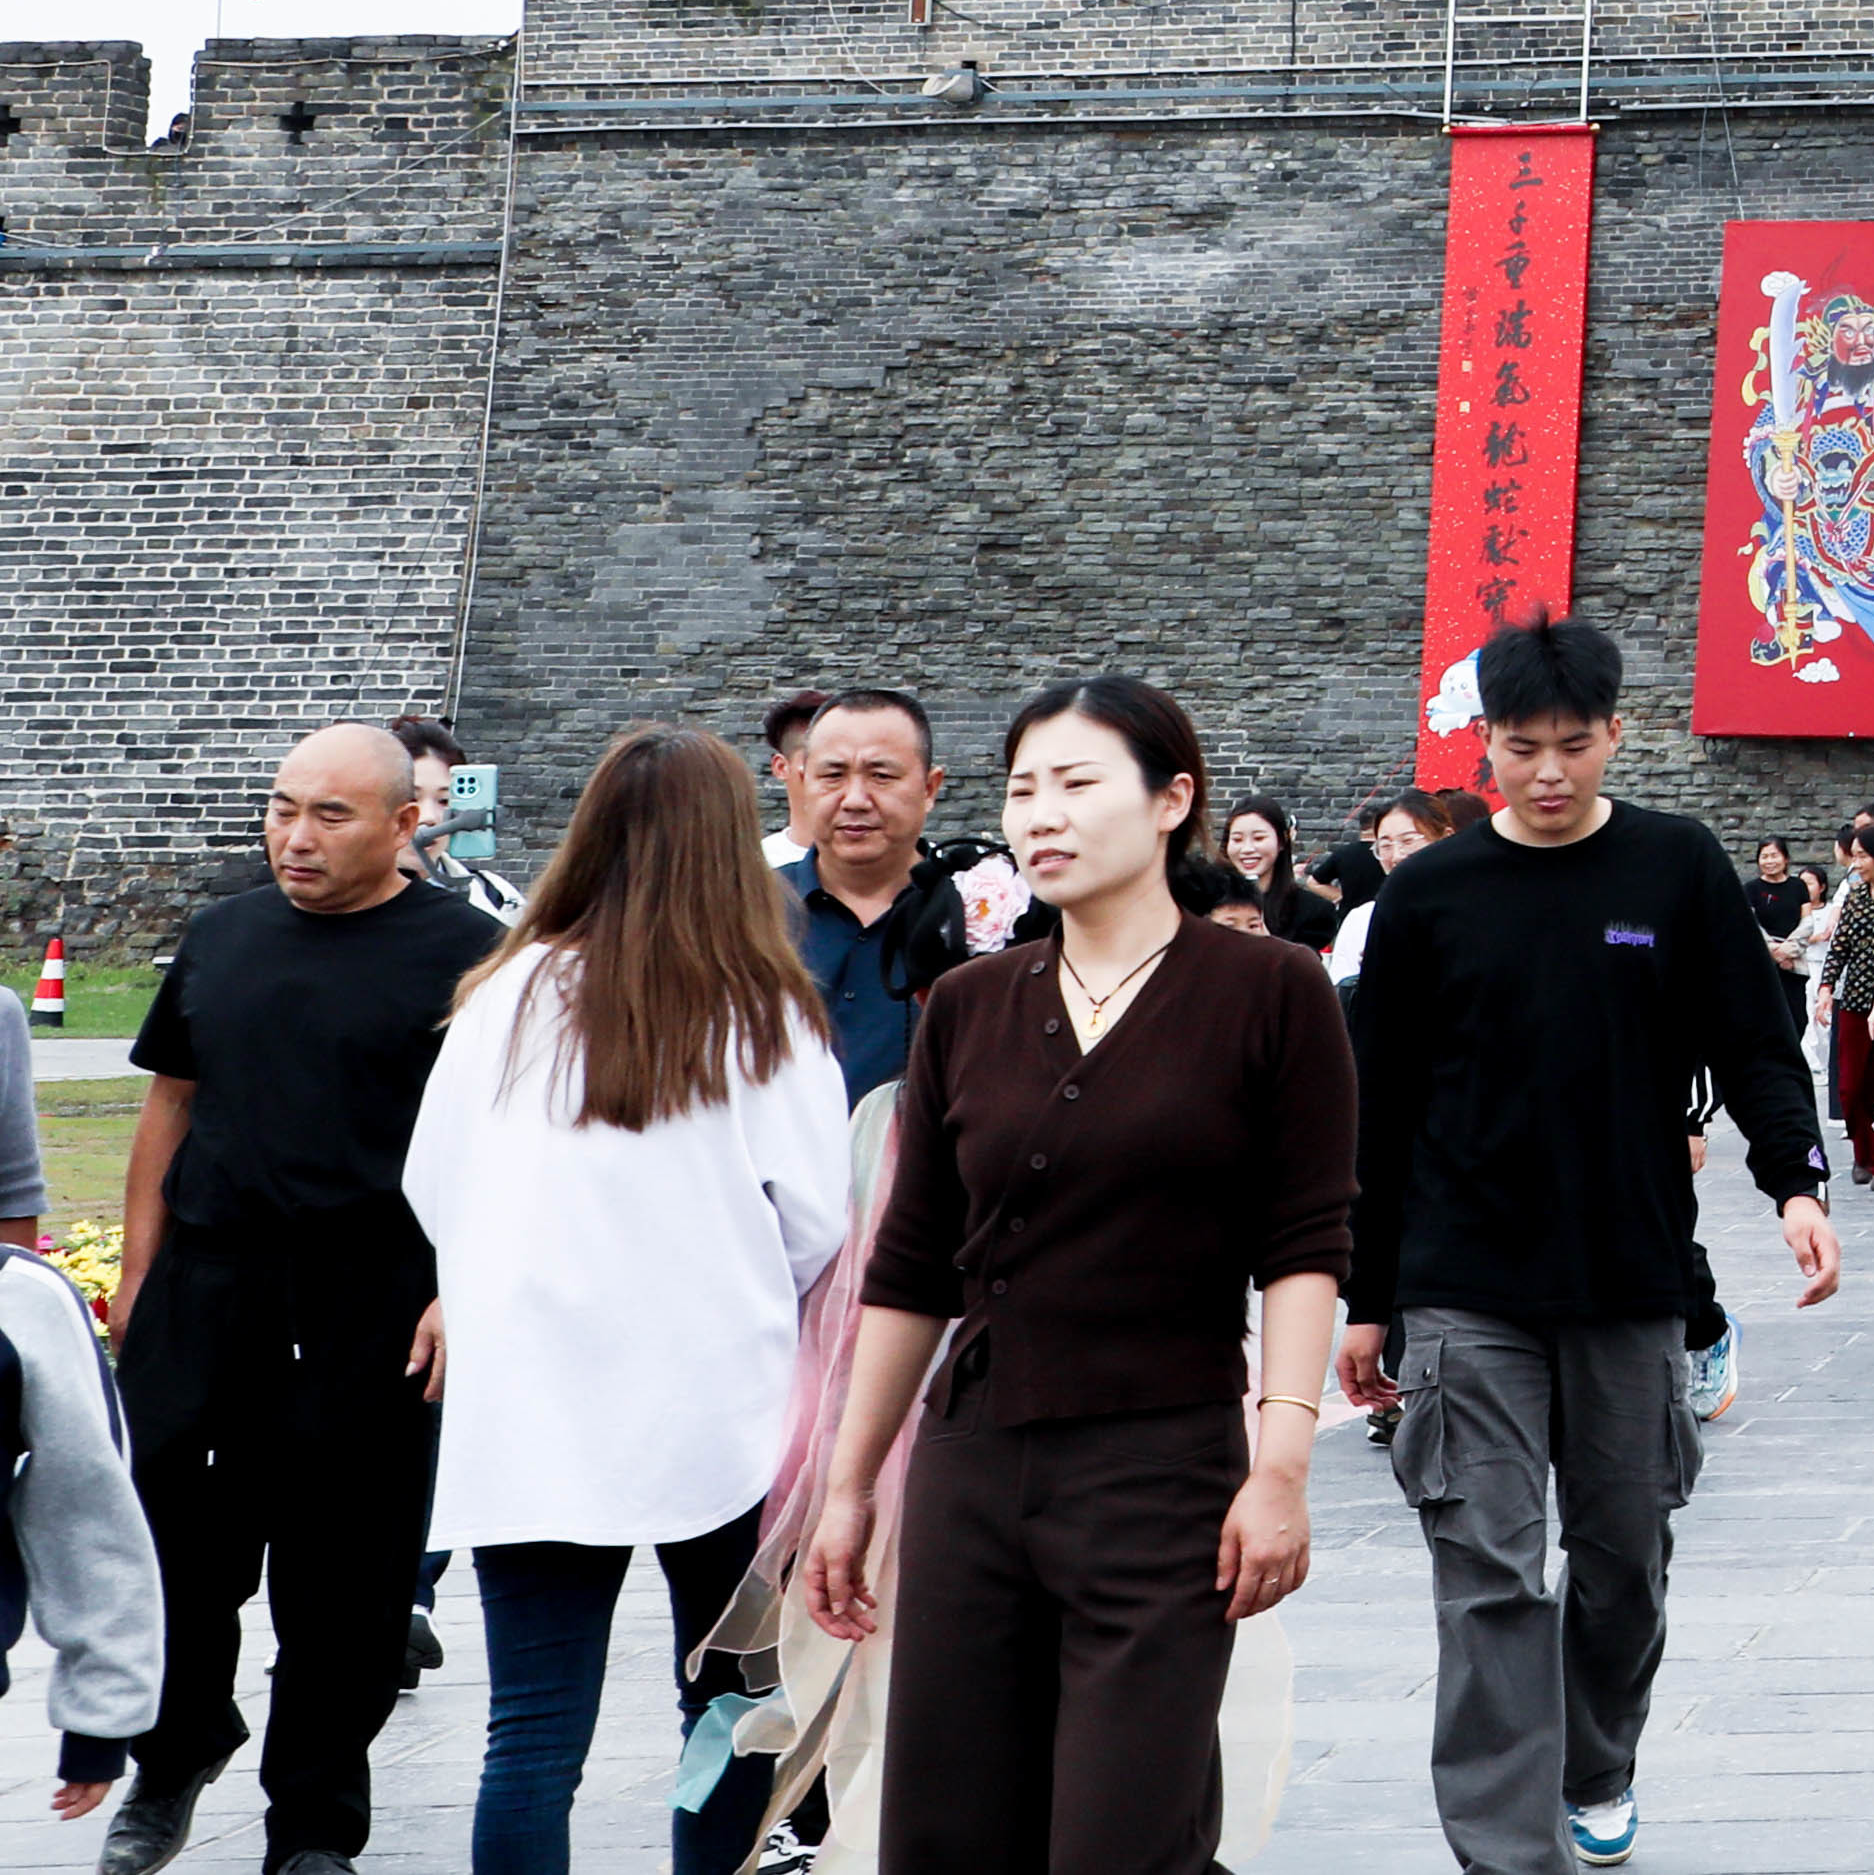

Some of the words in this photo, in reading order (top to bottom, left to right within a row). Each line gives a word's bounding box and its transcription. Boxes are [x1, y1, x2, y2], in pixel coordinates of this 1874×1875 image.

[1475, 152, 1543, 793] 三千重瑞氣龍蛇獻寶
